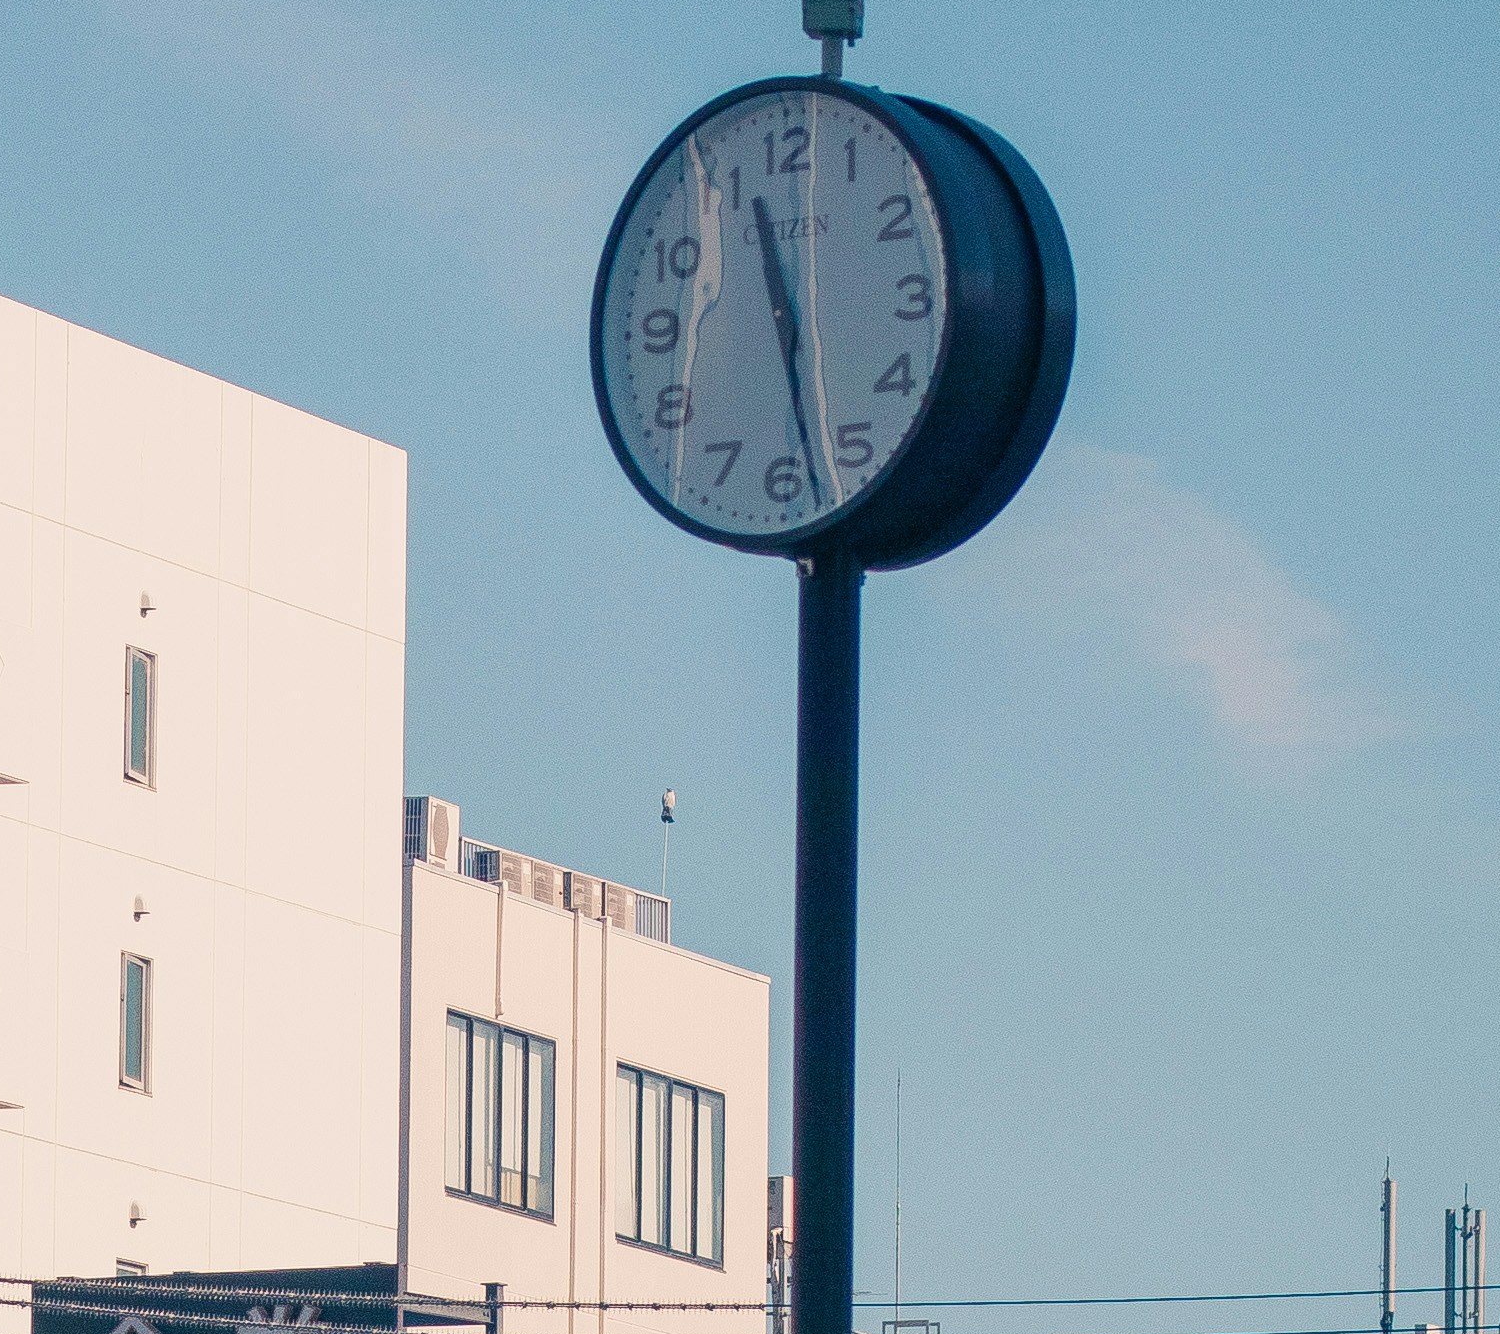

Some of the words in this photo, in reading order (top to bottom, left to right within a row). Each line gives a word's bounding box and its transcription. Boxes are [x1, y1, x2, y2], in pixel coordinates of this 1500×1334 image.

[763, 127, 811, 175] 12
[844, 137, 857, 181] 1
[743, 214, 829, 246] CIZEN
[877, 195, 913, 241] 2
[655, 237, 701, 279] 10
[894, 274, 931, 321] 3
[643, 310, 679, 354] 9
[873, 353, 915, 396] 4
[654, 386, 692, 430] 8
[706, 441, 743, 486] 7
[837, 422, 874, 467] 5
[764, 457, 801, 502] 6
